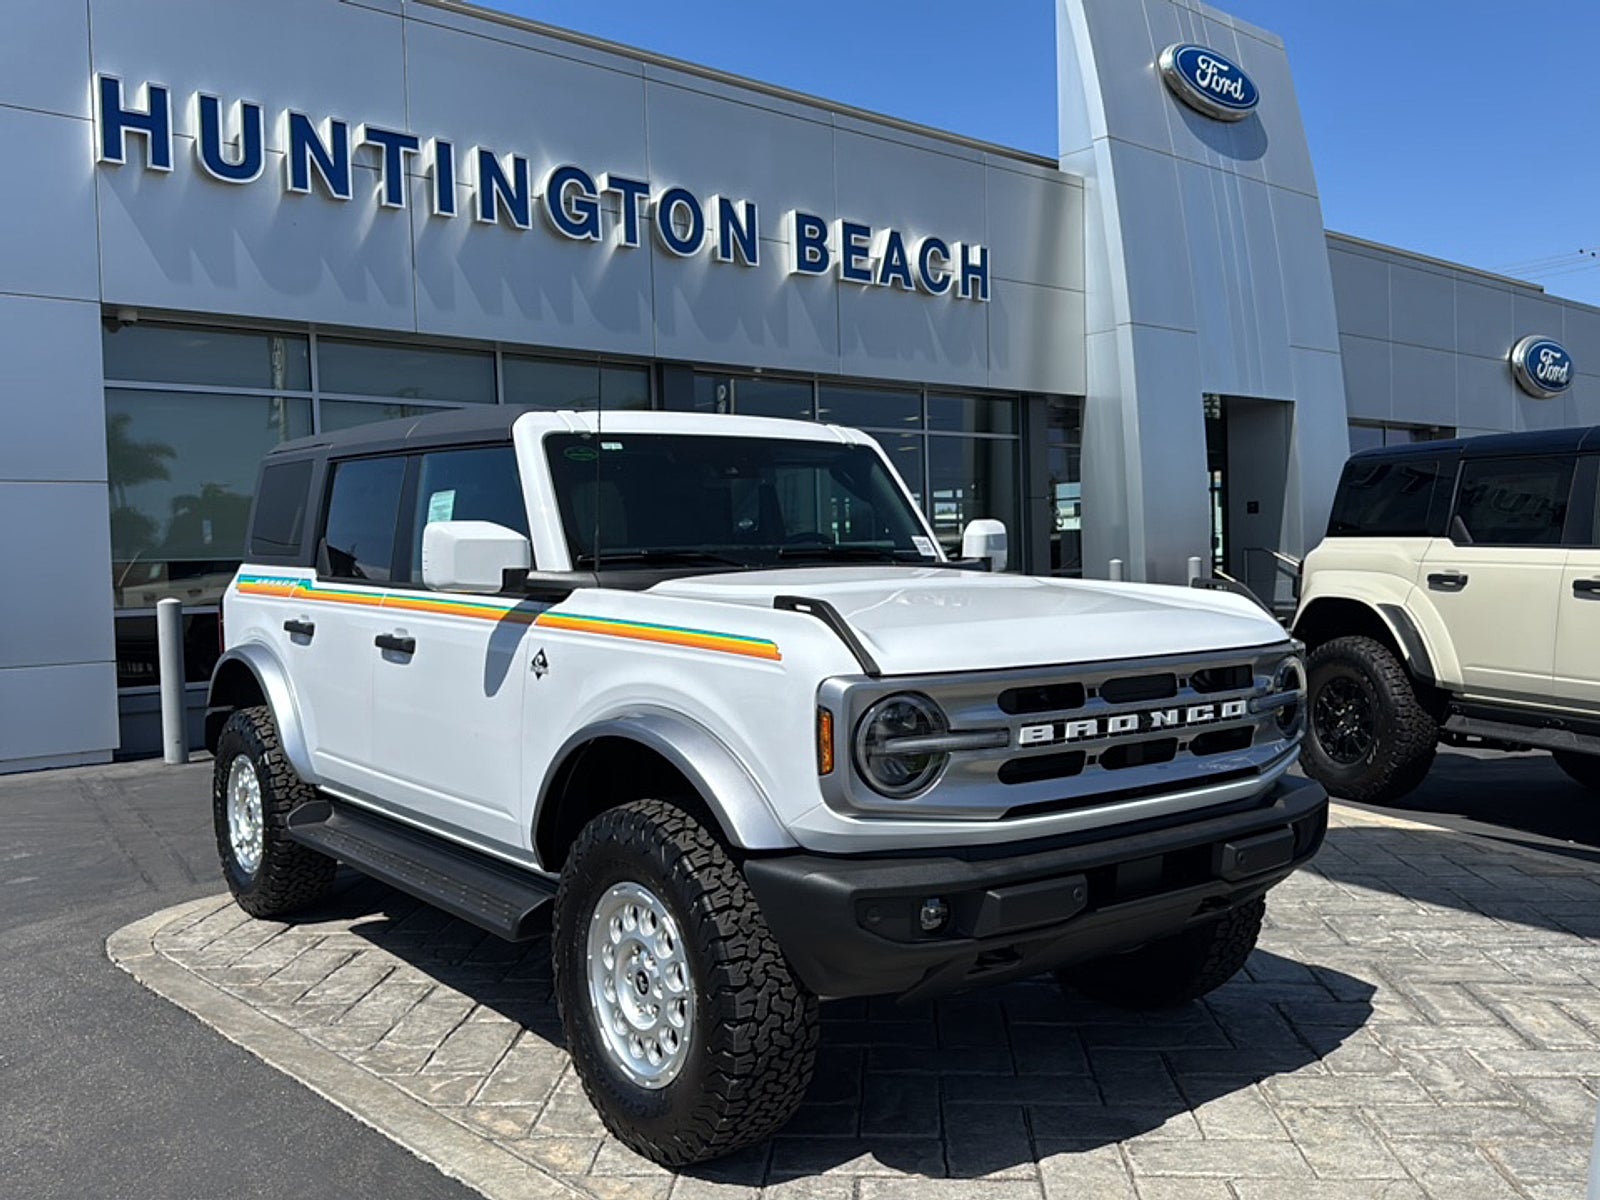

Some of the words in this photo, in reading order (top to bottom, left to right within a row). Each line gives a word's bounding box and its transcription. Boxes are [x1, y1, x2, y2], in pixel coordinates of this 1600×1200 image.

[1196, 55, 1244, 100] Ford
[95, 72, 759, 267] HUNTINGTON
[789, 209, 991, 302] BEACH
[1537, 348, 1569, 383] Ford
[1018, 699, 1248, 744] BRONCO
